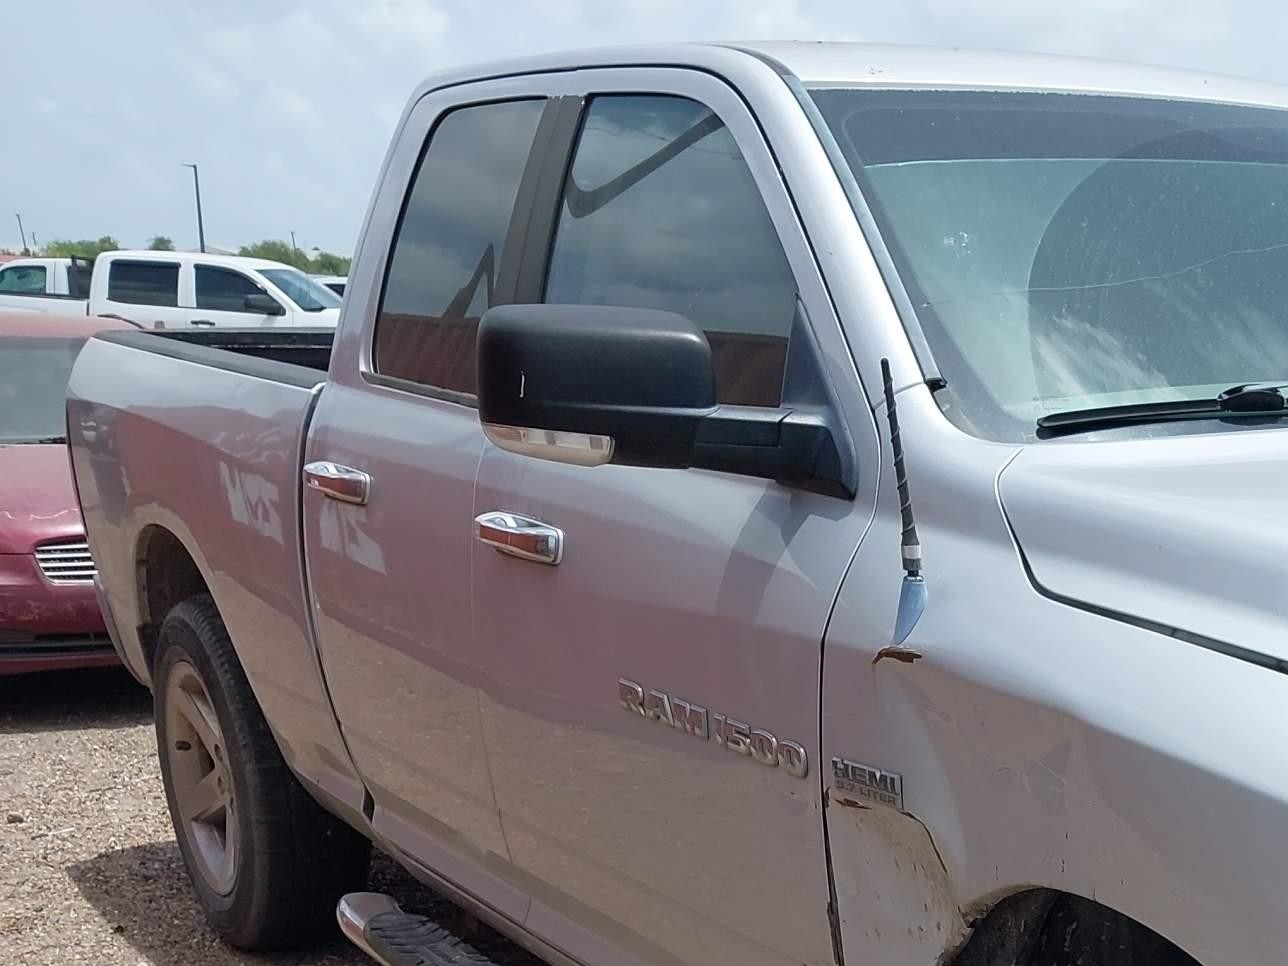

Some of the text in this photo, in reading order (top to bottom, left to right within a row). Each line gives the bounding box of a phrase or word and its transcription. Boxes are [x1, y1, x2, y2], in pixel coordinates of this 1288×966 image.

[617, 677, 808, 779] RAM 1500
[831, 756, 903, 796] HEMI
